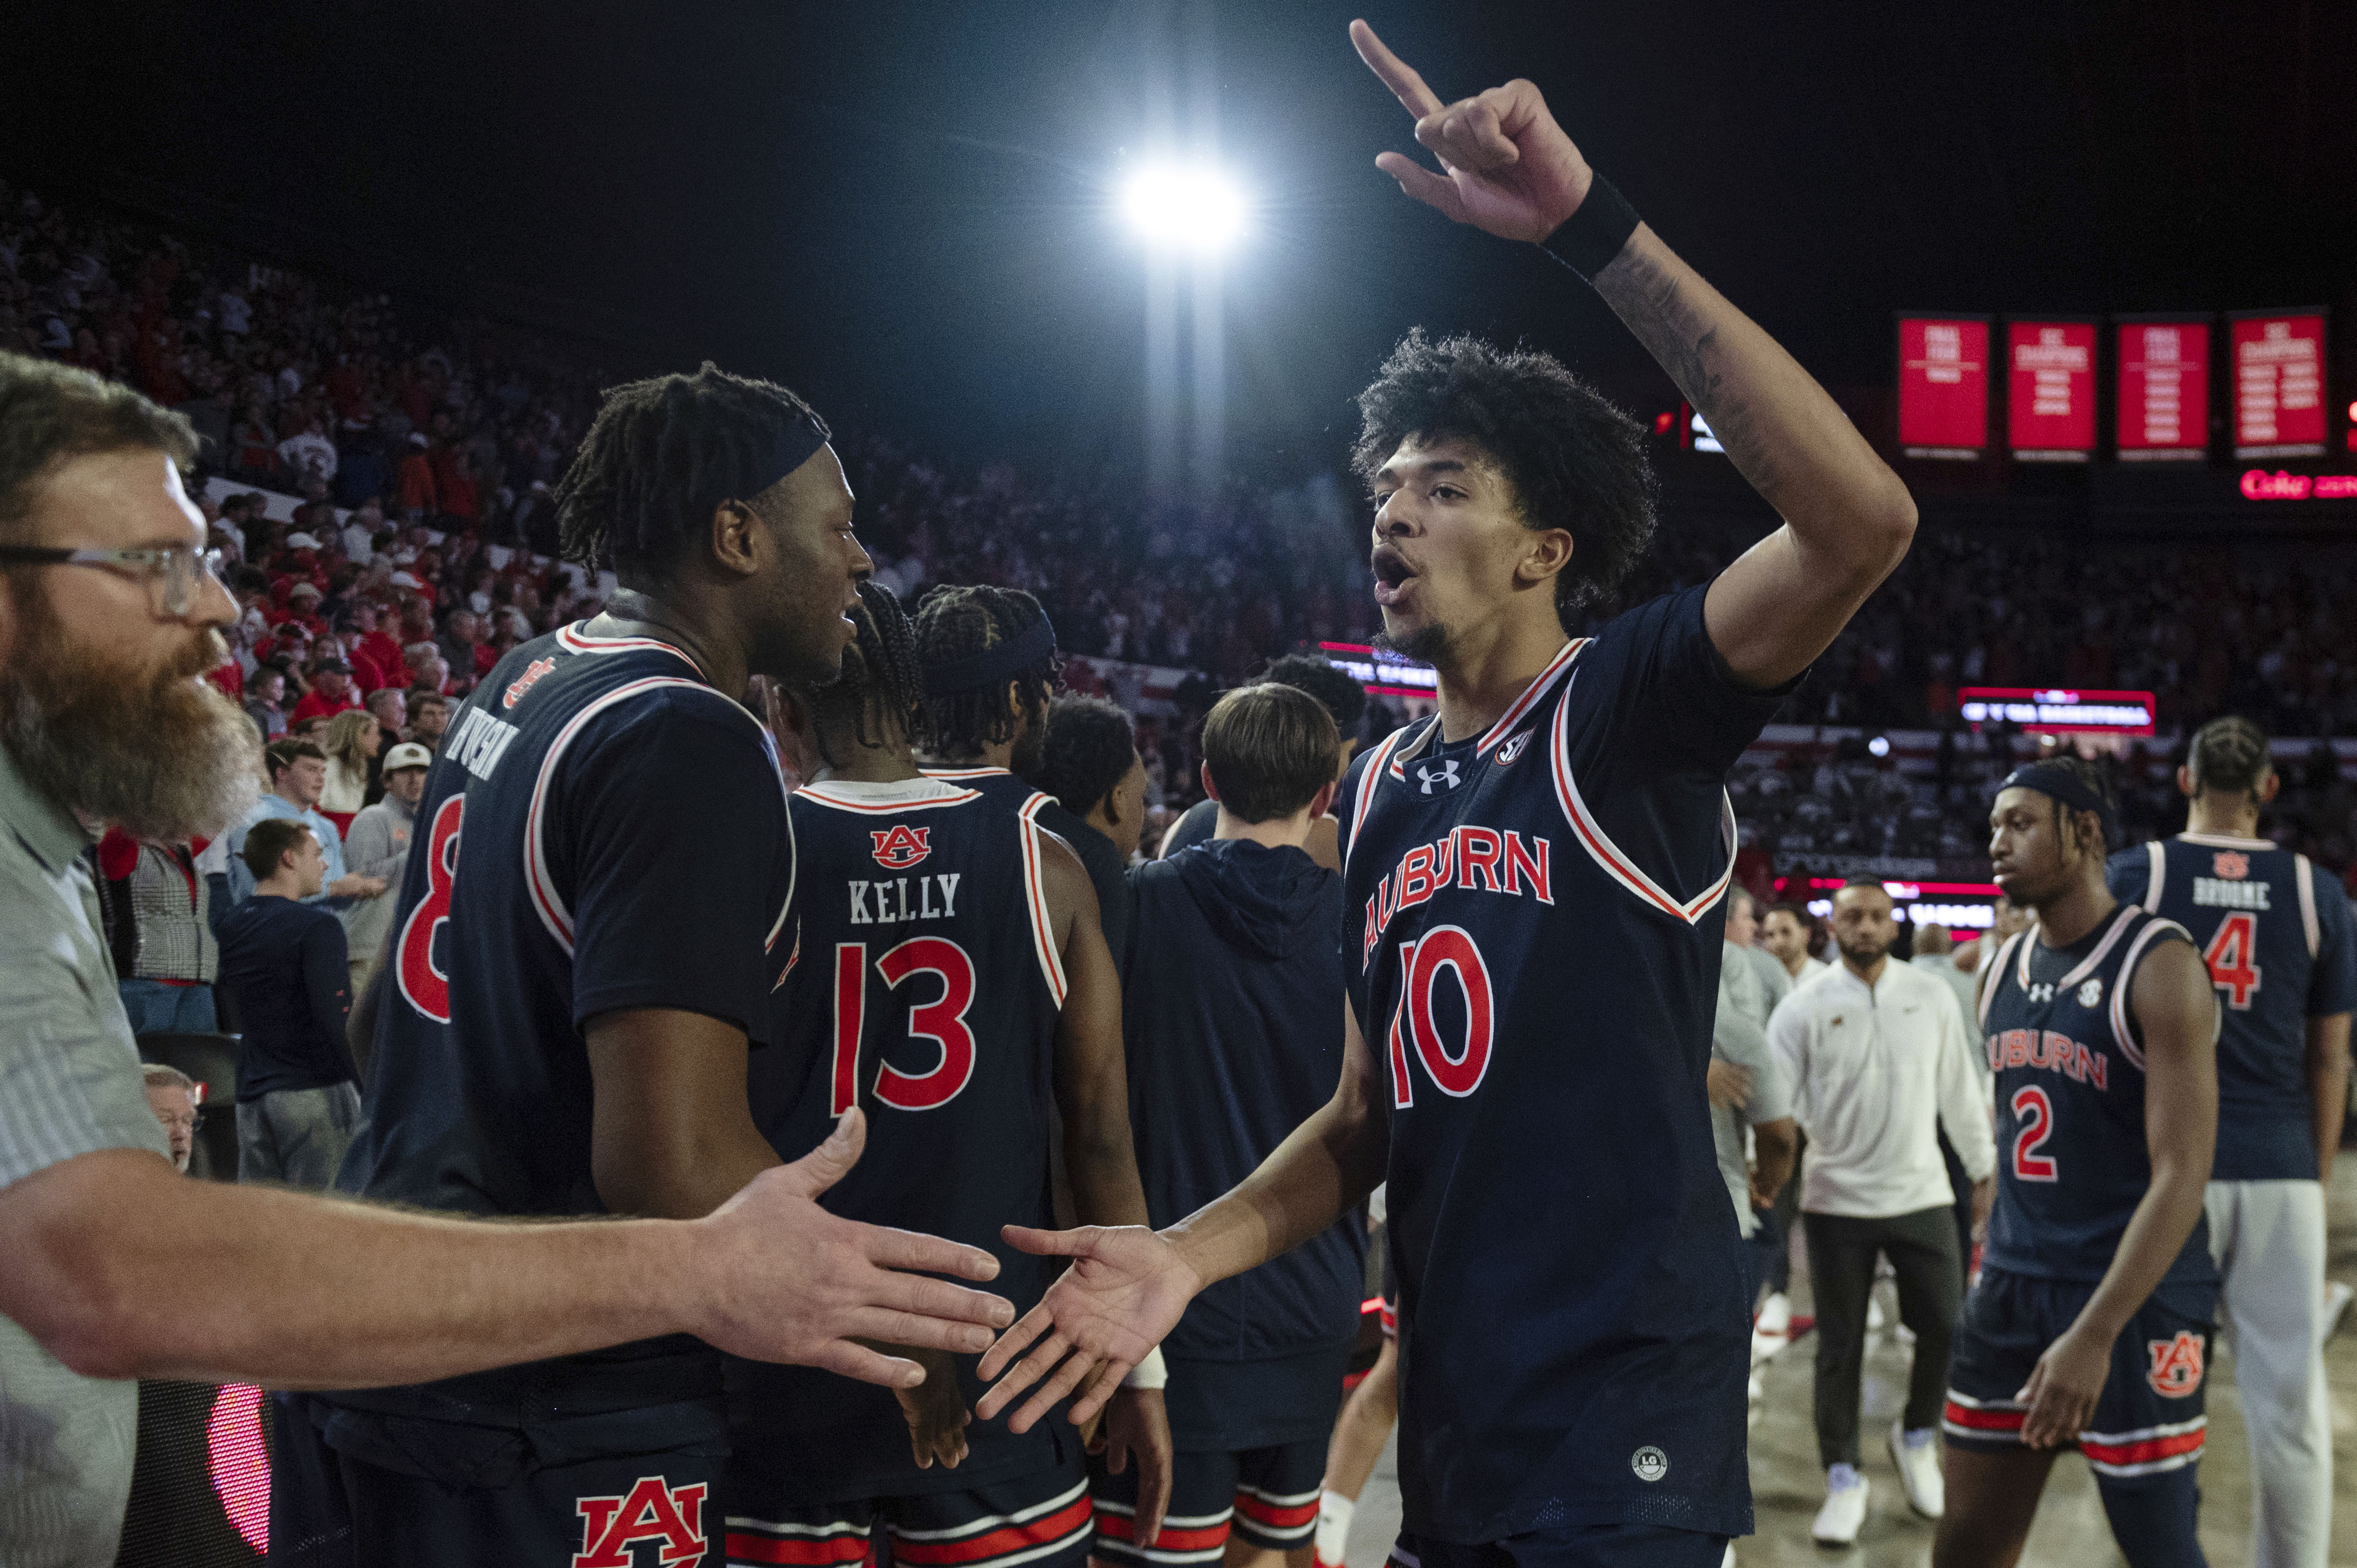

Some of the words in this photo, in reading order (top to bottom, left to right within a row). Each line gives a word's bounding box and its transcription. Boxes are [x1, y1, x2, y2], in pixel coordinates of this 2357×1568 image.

[848, 873, 961, 924] KELLY
[1362, 825, 1554, 976] AUBURN
[2204, 911, 2262, 1011] 4
[830, 935, 976, 1119] 13
[1390, 924, 1494, 1110] 10
[1988, 1029, 2108, 1091] UBURN
[2011, 1084, 2058, 1183] 2
